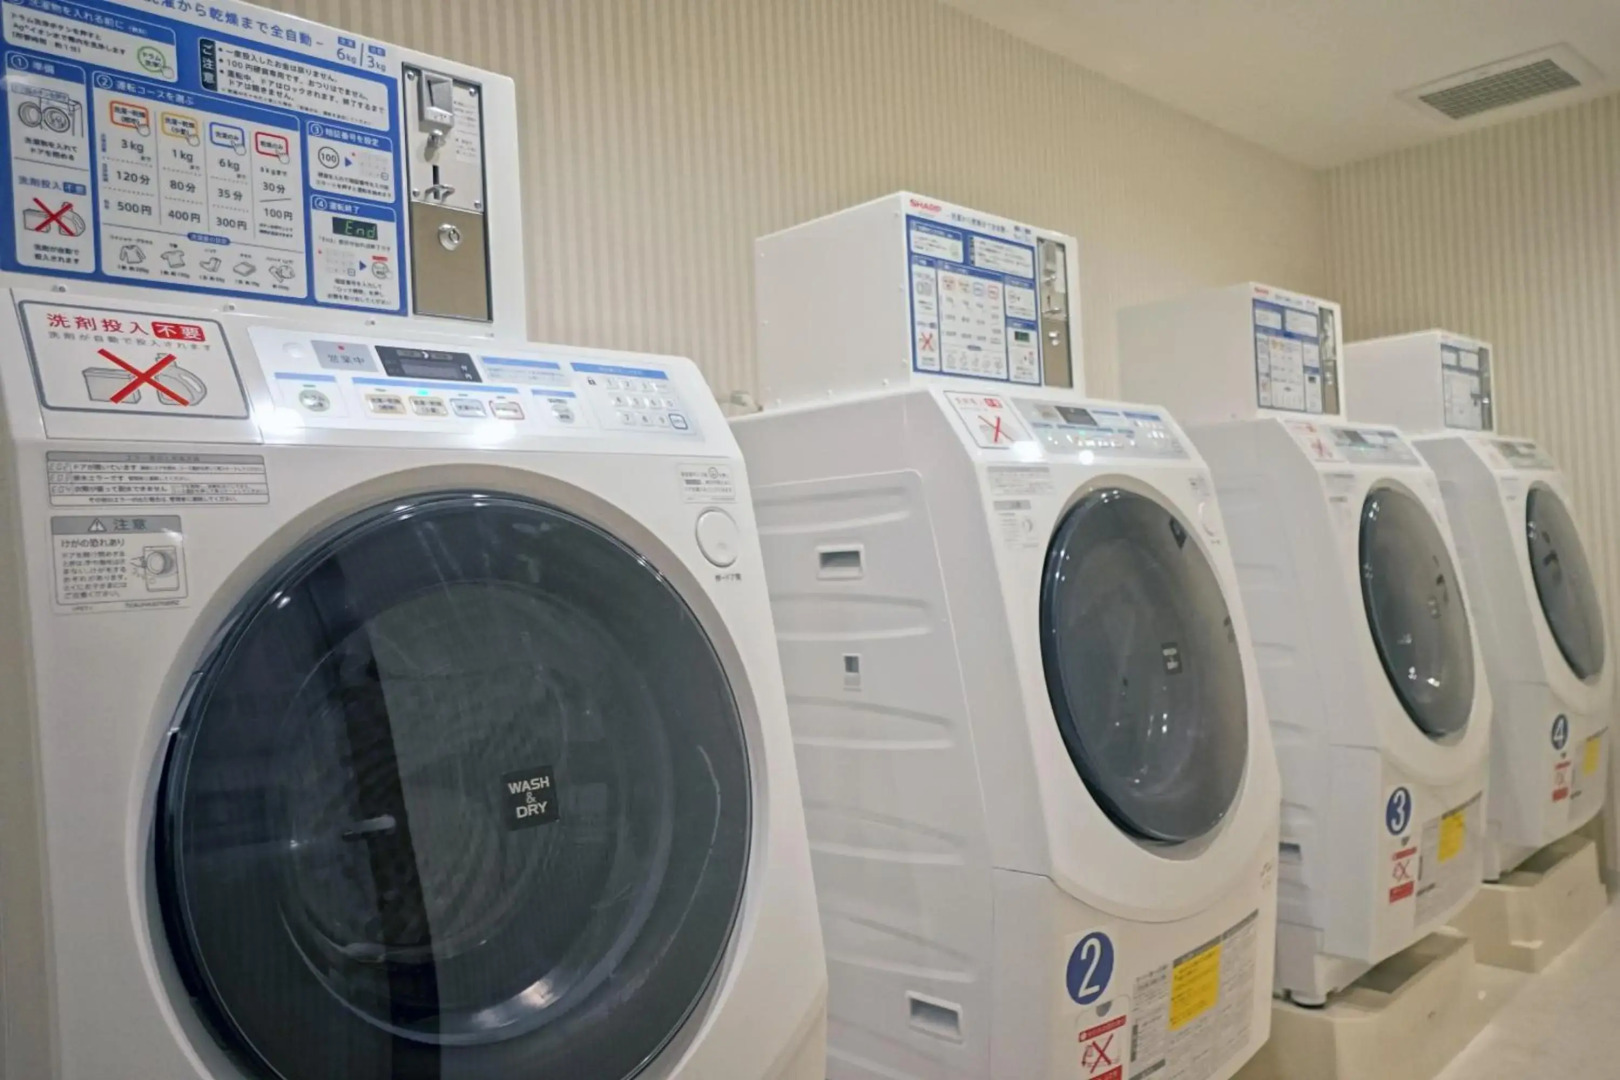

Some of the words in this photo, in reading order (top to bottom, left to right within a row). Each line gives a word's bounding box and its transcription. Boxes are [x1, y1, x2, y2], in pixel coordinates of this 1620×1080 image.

[320, 152, 338, 163] 100
[116, 170, 151, 186] 120分
[169, 179, 196, 194] 80分
[217, 187, 243, 202] 35分
[262, 181, 286, 195] 30分
[116, 200, 153, 217] 500円
[168, 209, 201, 224] 400円
[216, 216, 248, 231] 300円
[264, 206, 293, 222] 100円
[344, 220, 377, 240] End
[47, 312, 150, 336] 洗剤投入
[155, 323, 203, 341] 不要
[48, 330, 212, 352] 洗剤が自動で投入されます
[112, 518, 148, 532] 注意
[61, 537, 126, 548] けがの恐れあり
[1552, 719, 1565, 742] 4
[508, 776, 551, 795] WASH
[526, 791, 536, 804] &
[515, 801, 548, 819] DRY
[1391, 790, 1406, 833] 3
[1078, 937, 1101, 999] 2
